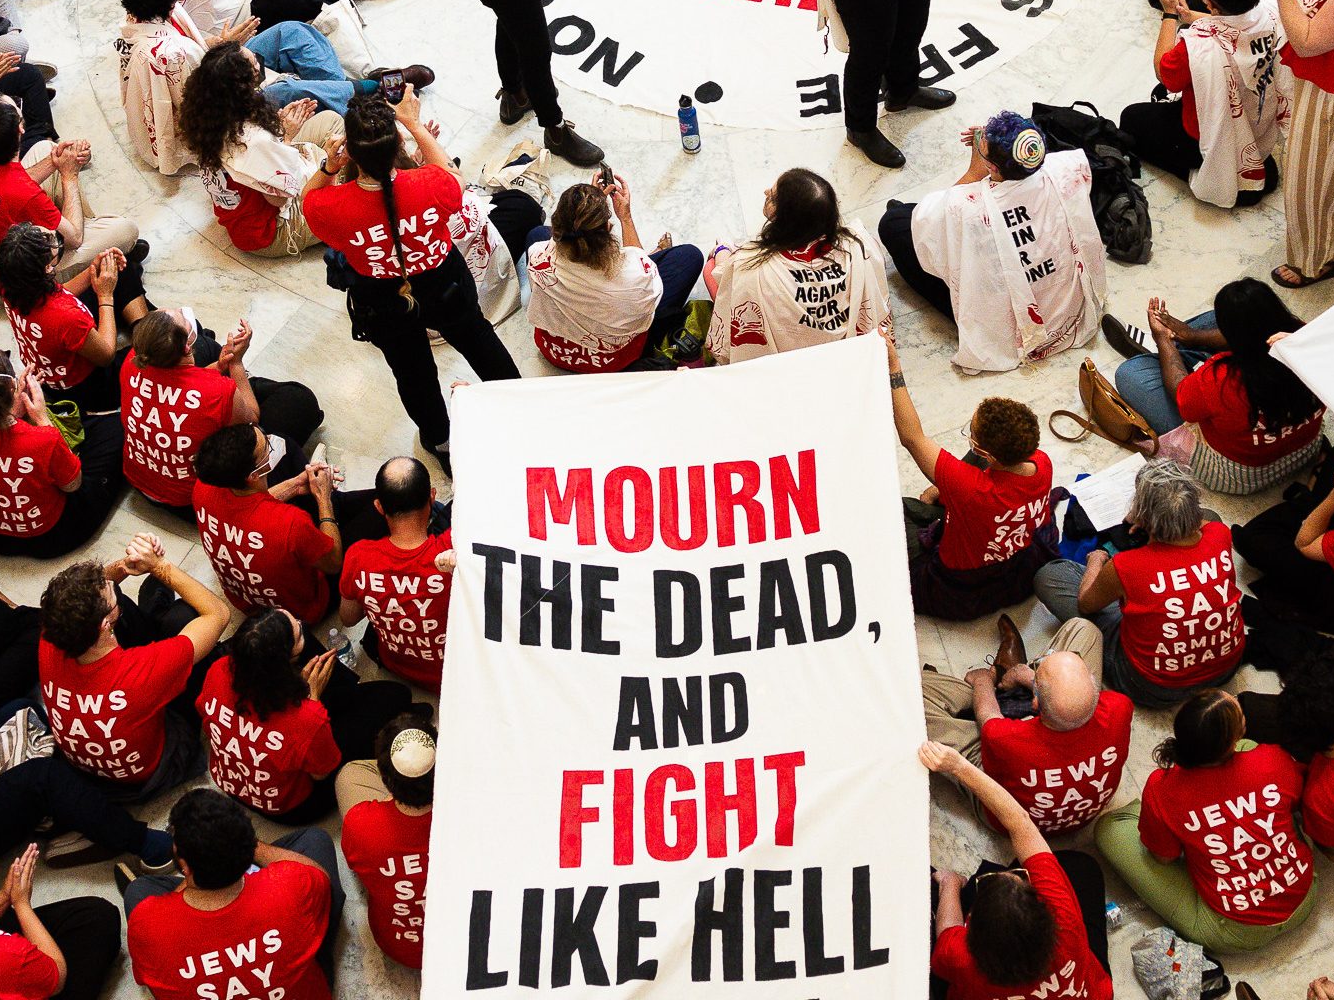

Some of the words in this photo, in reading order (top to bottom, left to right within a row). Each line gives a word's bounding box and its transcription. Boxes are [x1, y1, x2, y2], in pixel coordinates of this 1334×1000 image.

[788, 259, 847, 284] NEVER
[795, 280, 847, 304] AGAIN
[807, 299, 839, 320] FOR
[129, 372, 202, 409] JEWS
[127, 415, 192, 452] STOP
[130, 396, 188, 433] SAY
[525, 449, 820, 552] MOURN
[196, 507, 264, 549] JEWS
[203, 531, 254, 570] SAY
[355, 570, 444, 594] JEWS
[1149, 550, 1233, 593] JEWS
[364, 595, 433, 617] SAY
[472, 542, 622, 656] THE
[653, 550, 883, 659] DEAD,
[1165, 578, 1230, 619] SAY
[1162, 602, 1237, 639] STOP
[44, 680, 127, 714] JEWS
[613, 672, 748, 751] AND
[51, 707, 117, 739] SAY
[205, 697, 284, 751] JEWS
[209, 722, 267, 766] SAY
[1021, 746, 1117, 788] JEWS
[559, 751, 806, 868] FIGHT
[1029, 788, 1113, 819] STOP
[1034, 772, 1110, 809] SAY
[1184, 784, 1281, 832] JEWS
[1203, 812, 1276, 855] SAY
[1210, 832, 1288, 875] STOP
[1216, 842, 1298, 893] ARMING
[1222, 861, 1308, 912] ISRAEL
[466, 881, 661, 991] LIKE
[692, 865, 891, 982] HELL
[179, 929, 282, 979] JEWS
[197, 961, 274, 1000] SAY
